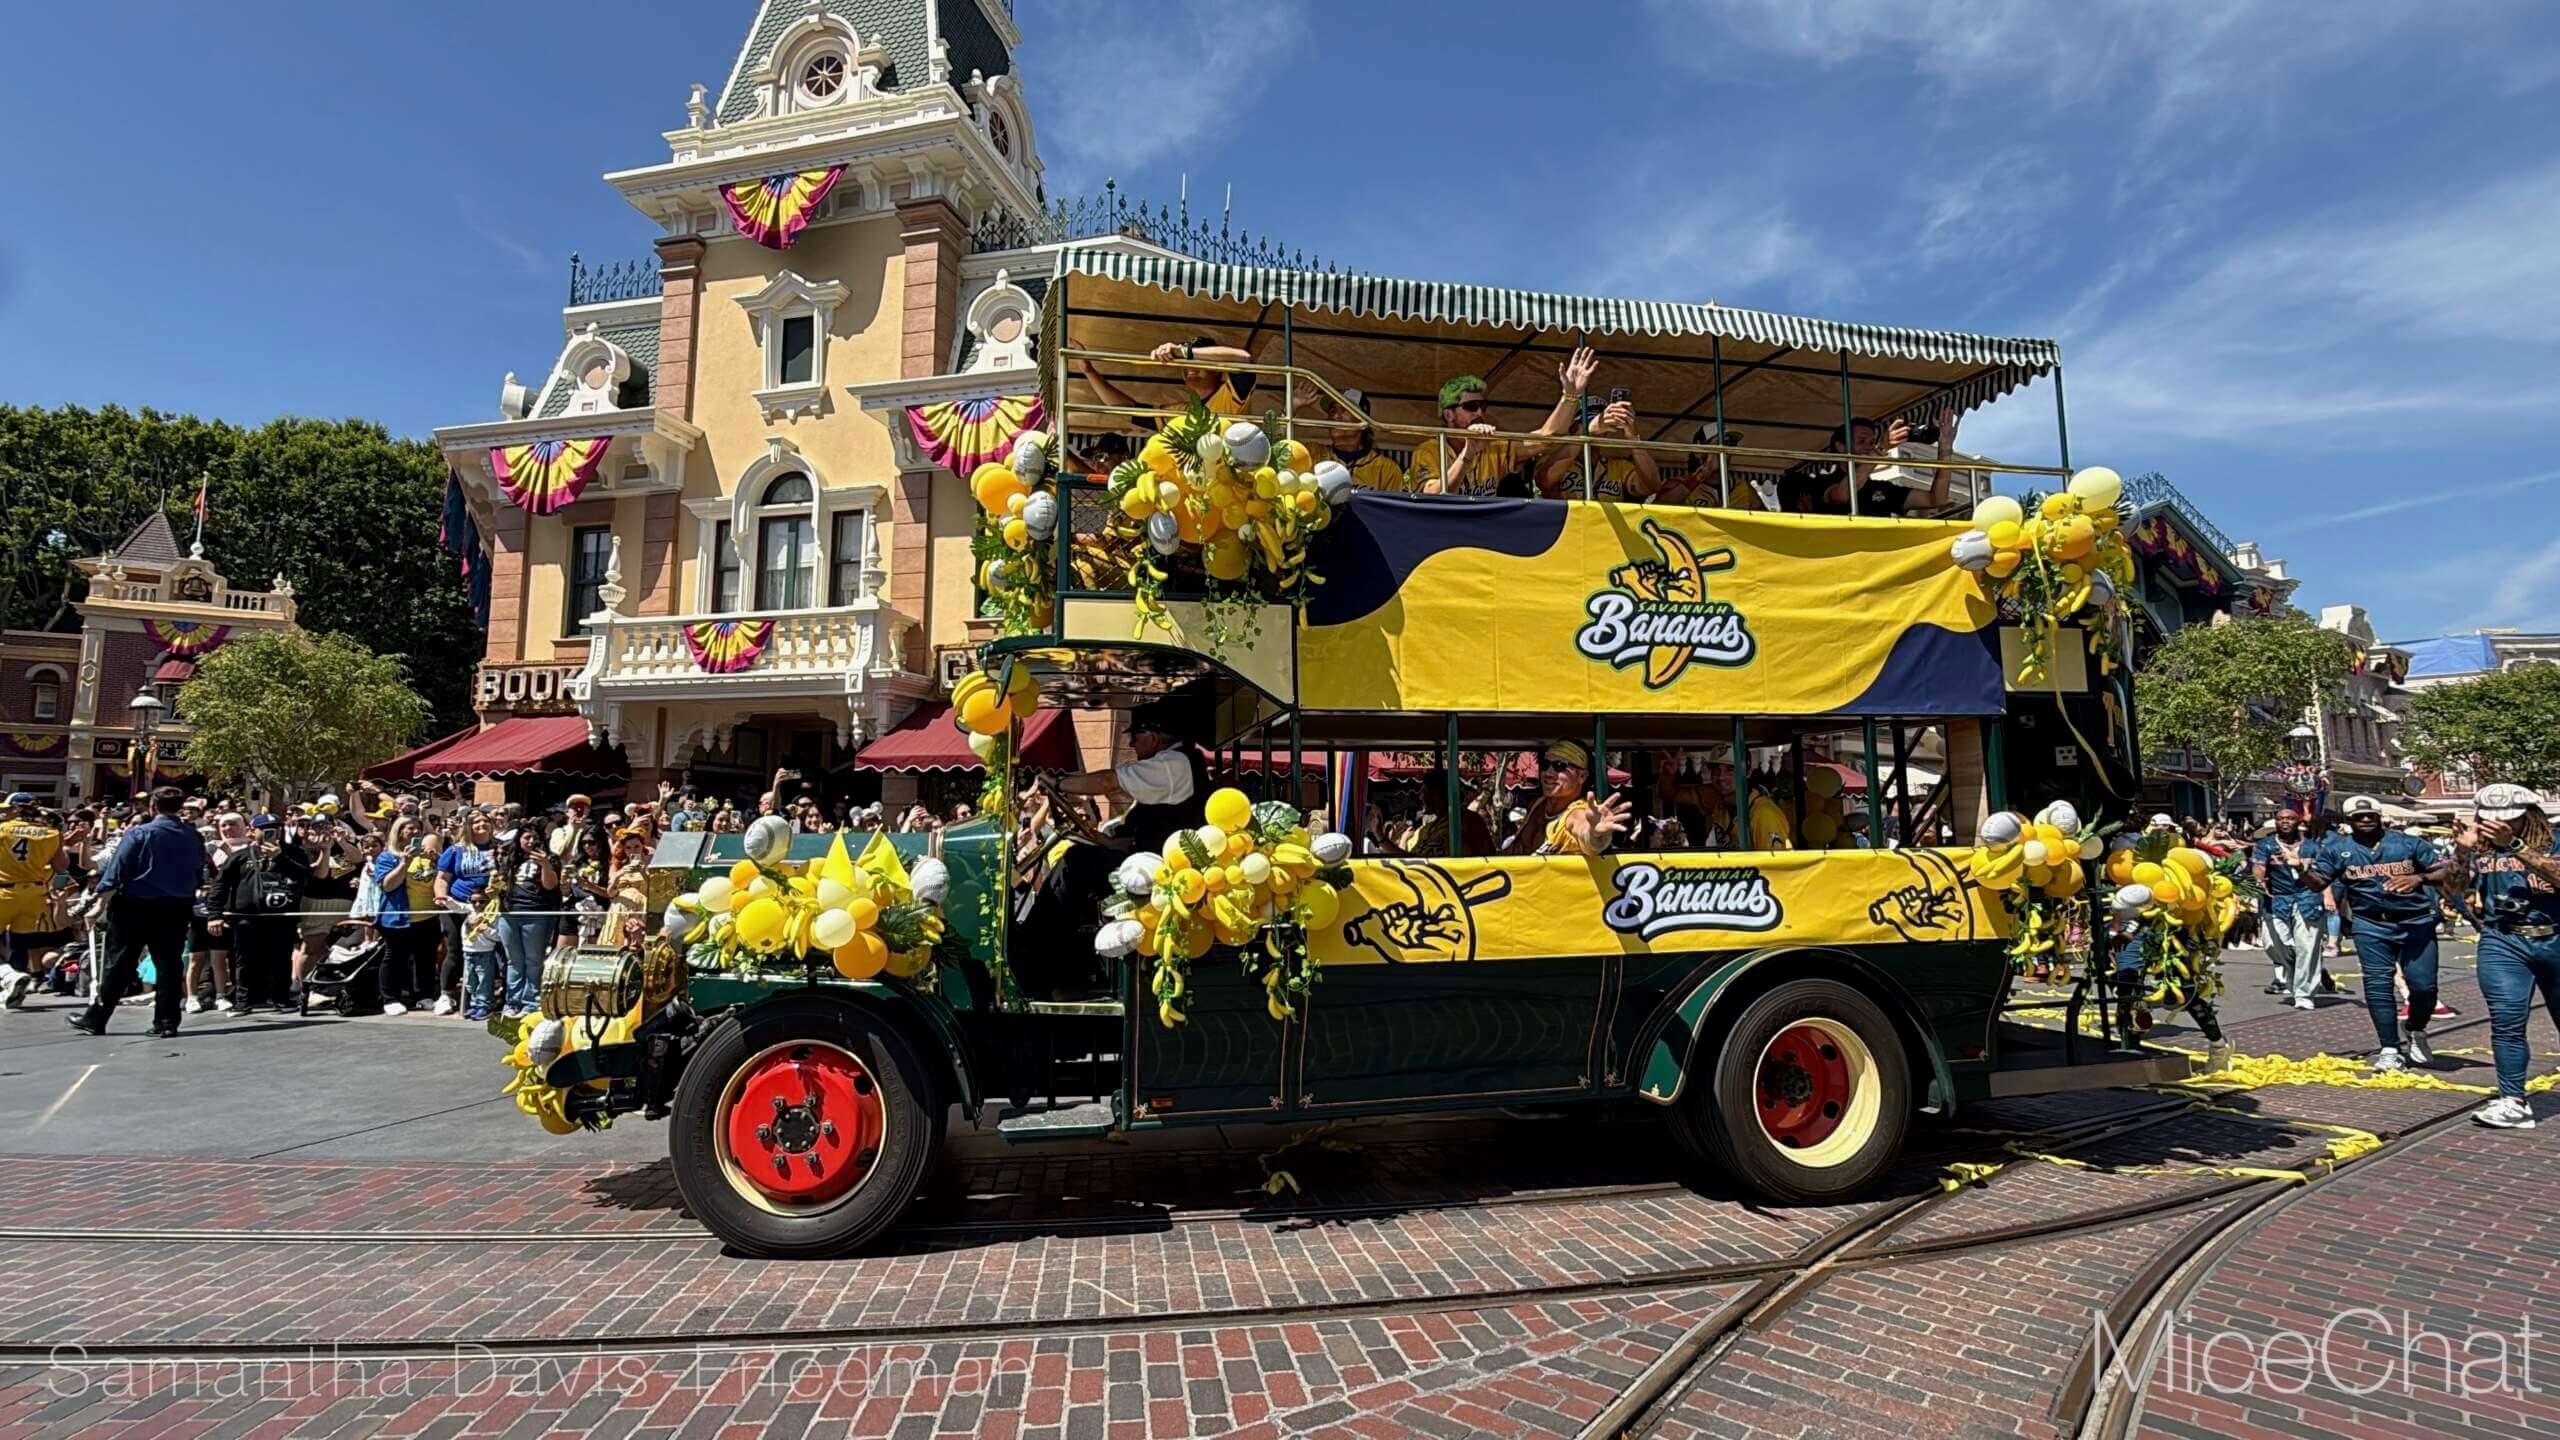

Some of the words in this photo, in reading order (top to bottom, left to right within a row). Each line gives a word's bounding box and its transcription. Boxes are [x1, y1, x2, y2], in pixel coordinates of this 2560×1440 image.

[1560, 471, 1621, 496] Banas
[1638, 601, 1728, 614] SAVANNAH
[1579, 593, 1750, 661] Bananas
[12, 838, 28, 861] 4
[1663, 869, 1753, 883] SAVANNAH
[1606, 865, 1777, 936] Bananas
